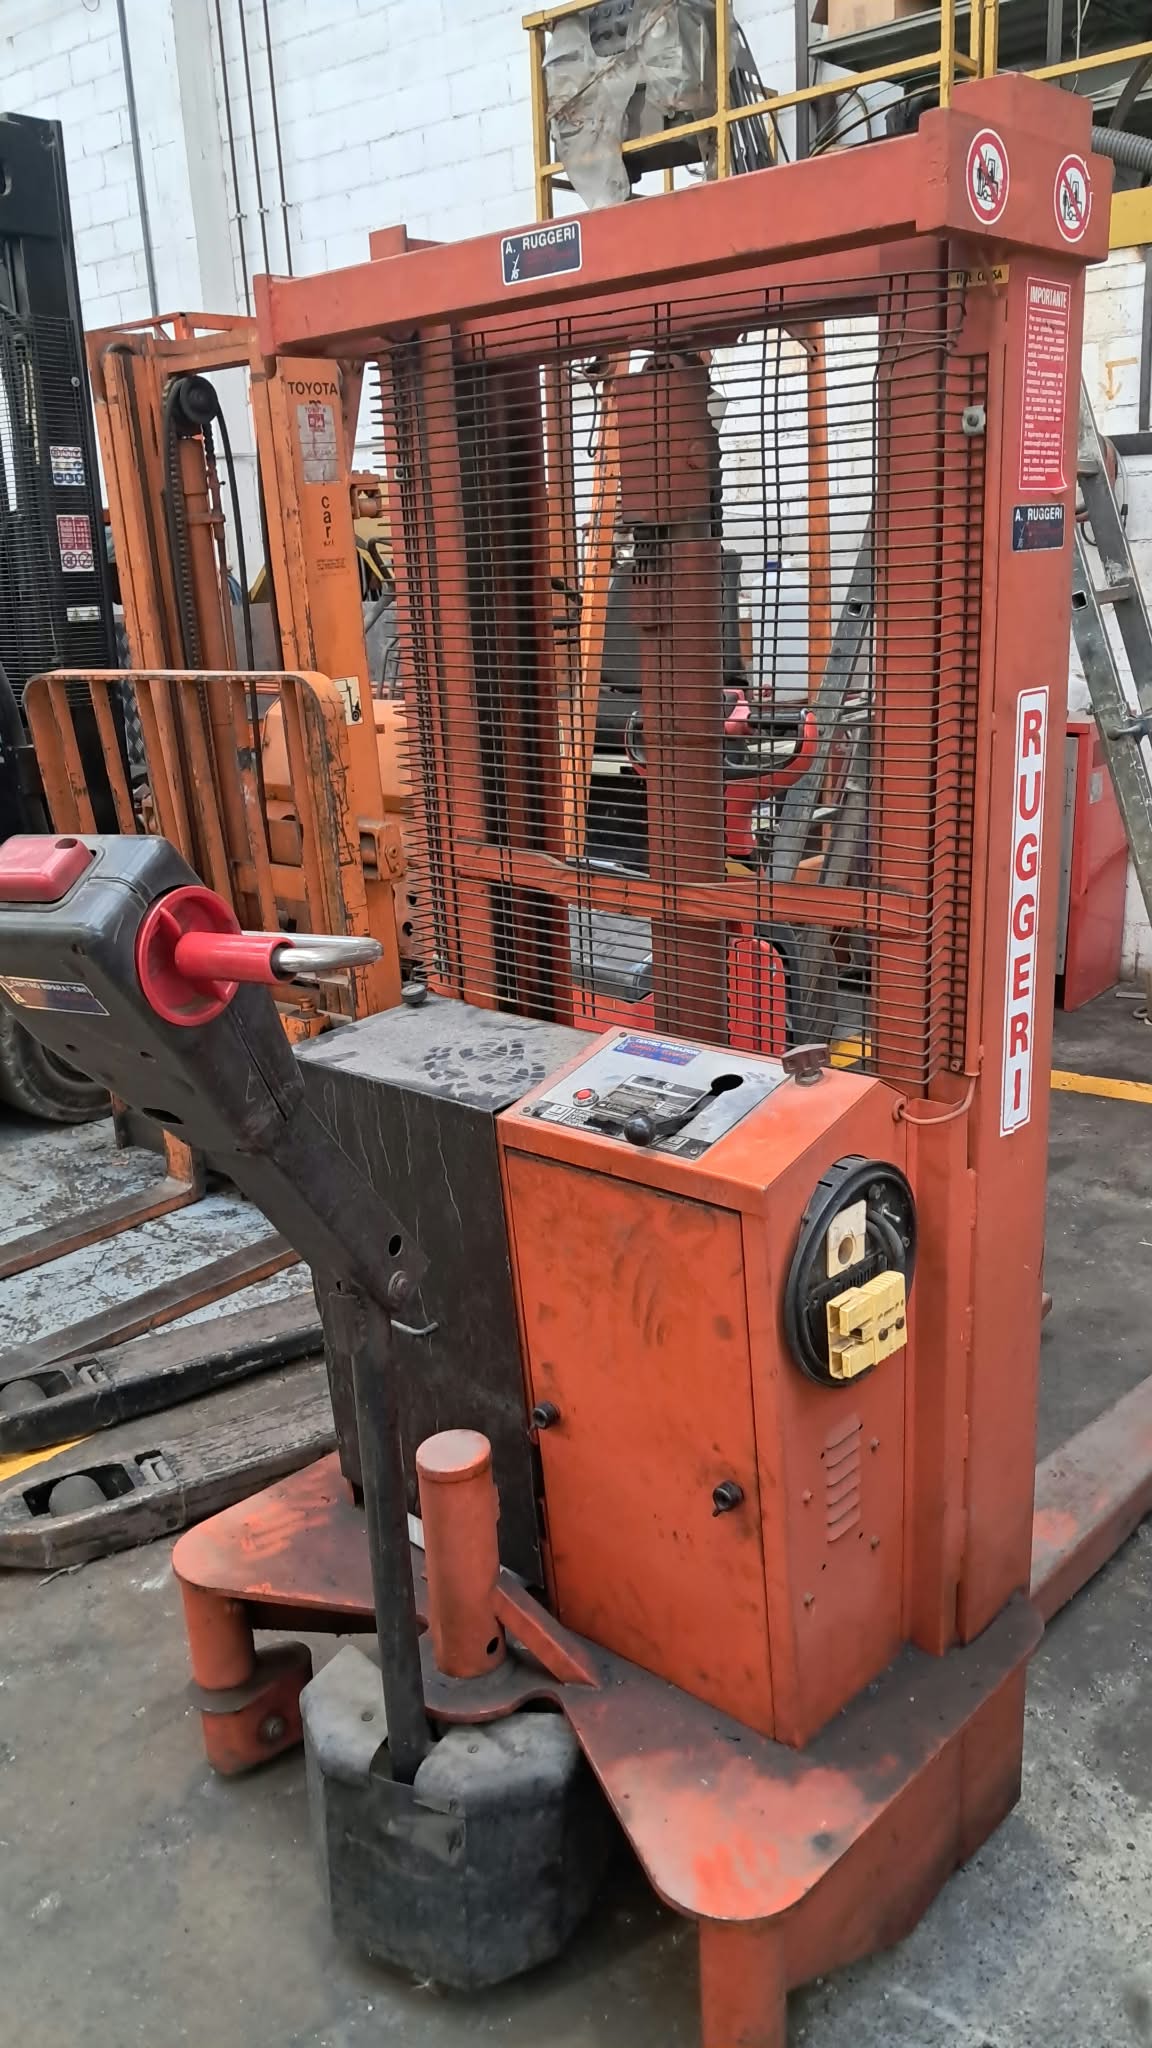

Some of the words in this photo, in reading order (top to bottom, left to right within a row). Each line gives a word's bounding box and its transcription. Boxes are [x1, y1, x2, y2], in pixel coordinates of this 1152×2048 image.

[505, 241, 517, 255] A.
[522, 225, 576, 251] RUGGERI
[1029, 284, 1068, 309] IMPORTANTE
[287, 381, 338, 396] TOYOTA
[1014, 508, 1024, 522] A.
[1027, 506, 1063, 521] RUGGERI
[1009, 708, 1042, 1111] RUGGERI
[635, 1038, 661, 1047] CENTRO
